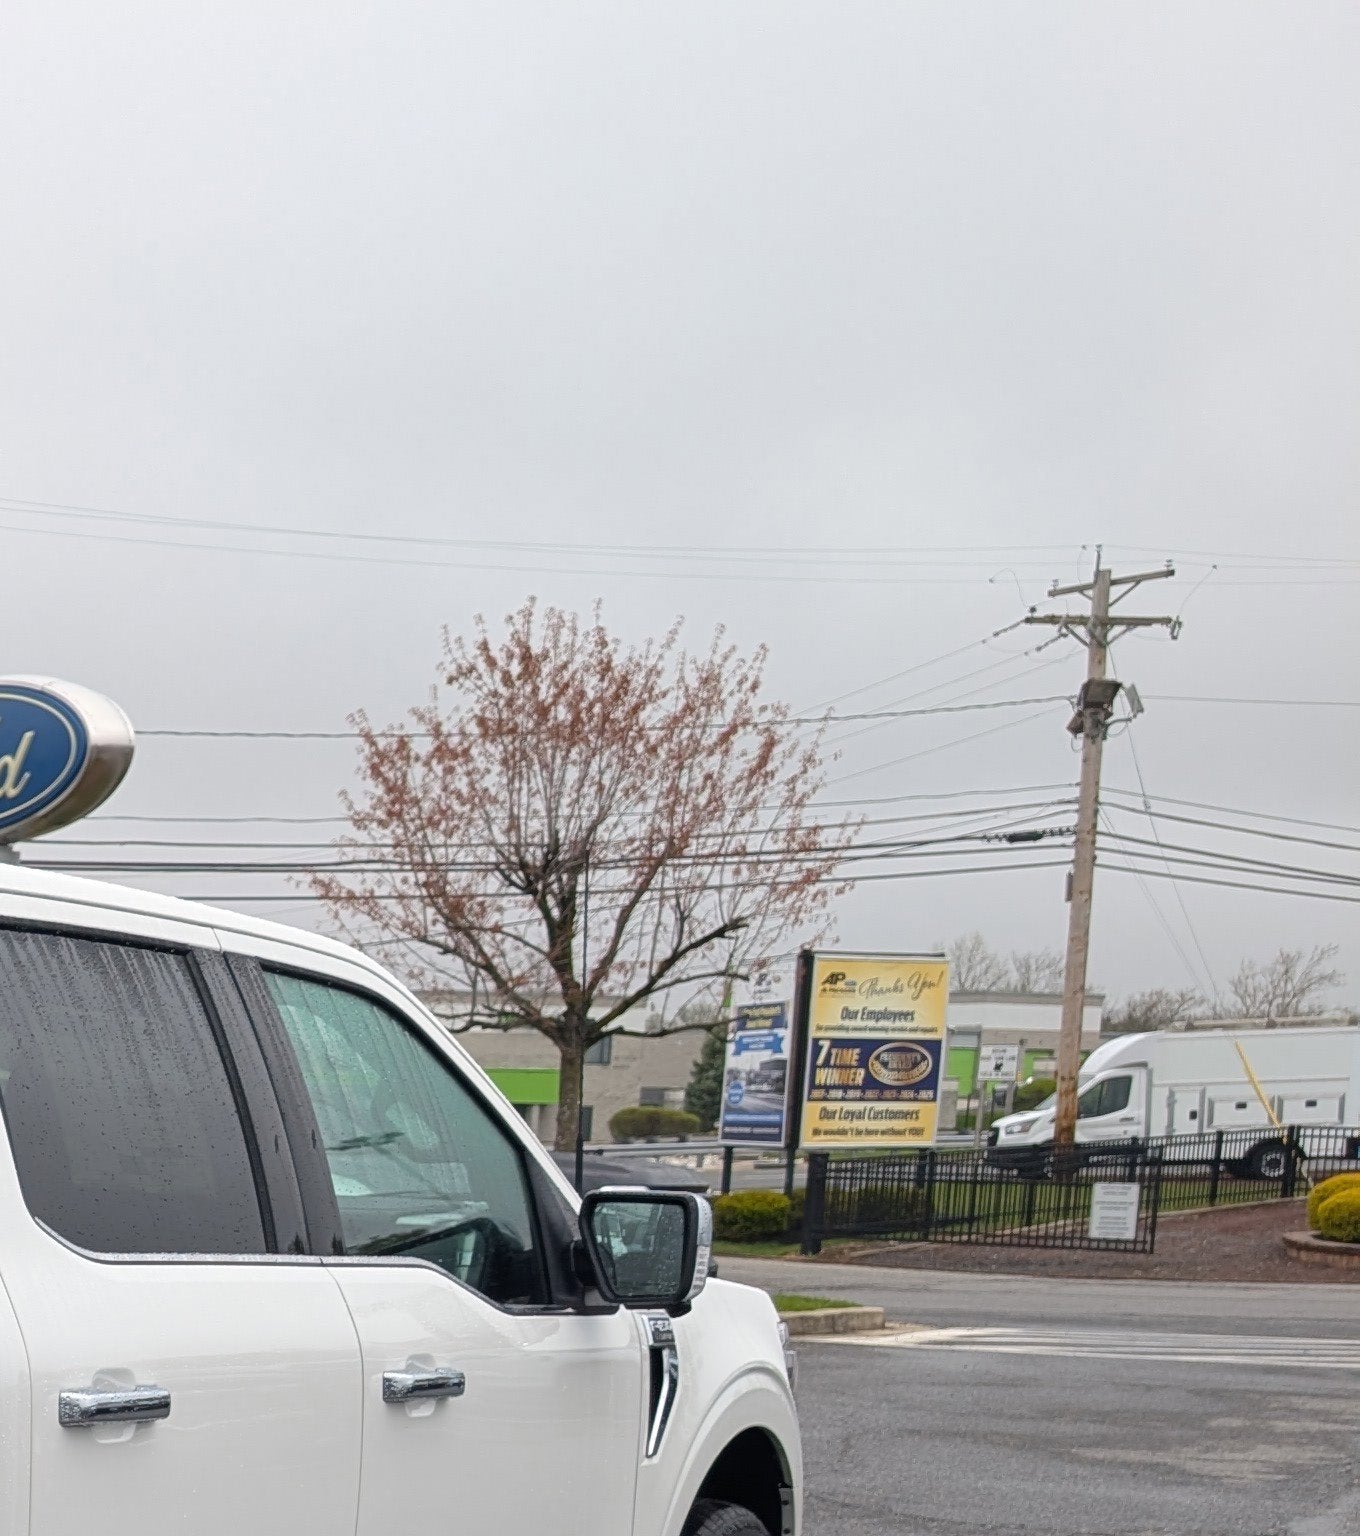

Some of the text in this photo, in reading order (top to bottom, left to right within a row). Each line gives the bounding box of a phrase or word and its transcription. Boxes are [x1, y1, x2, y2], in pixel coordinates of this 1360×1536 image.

[841, 1006, 916, 1023] Our Employees
[816, 1039, 830, 1066] 7
[830, 1047, 860, 1066] TIME
[815, 1067, 865, 1087] WINNER
[819, 1106, 920, 1121] Our Loyal Customers
